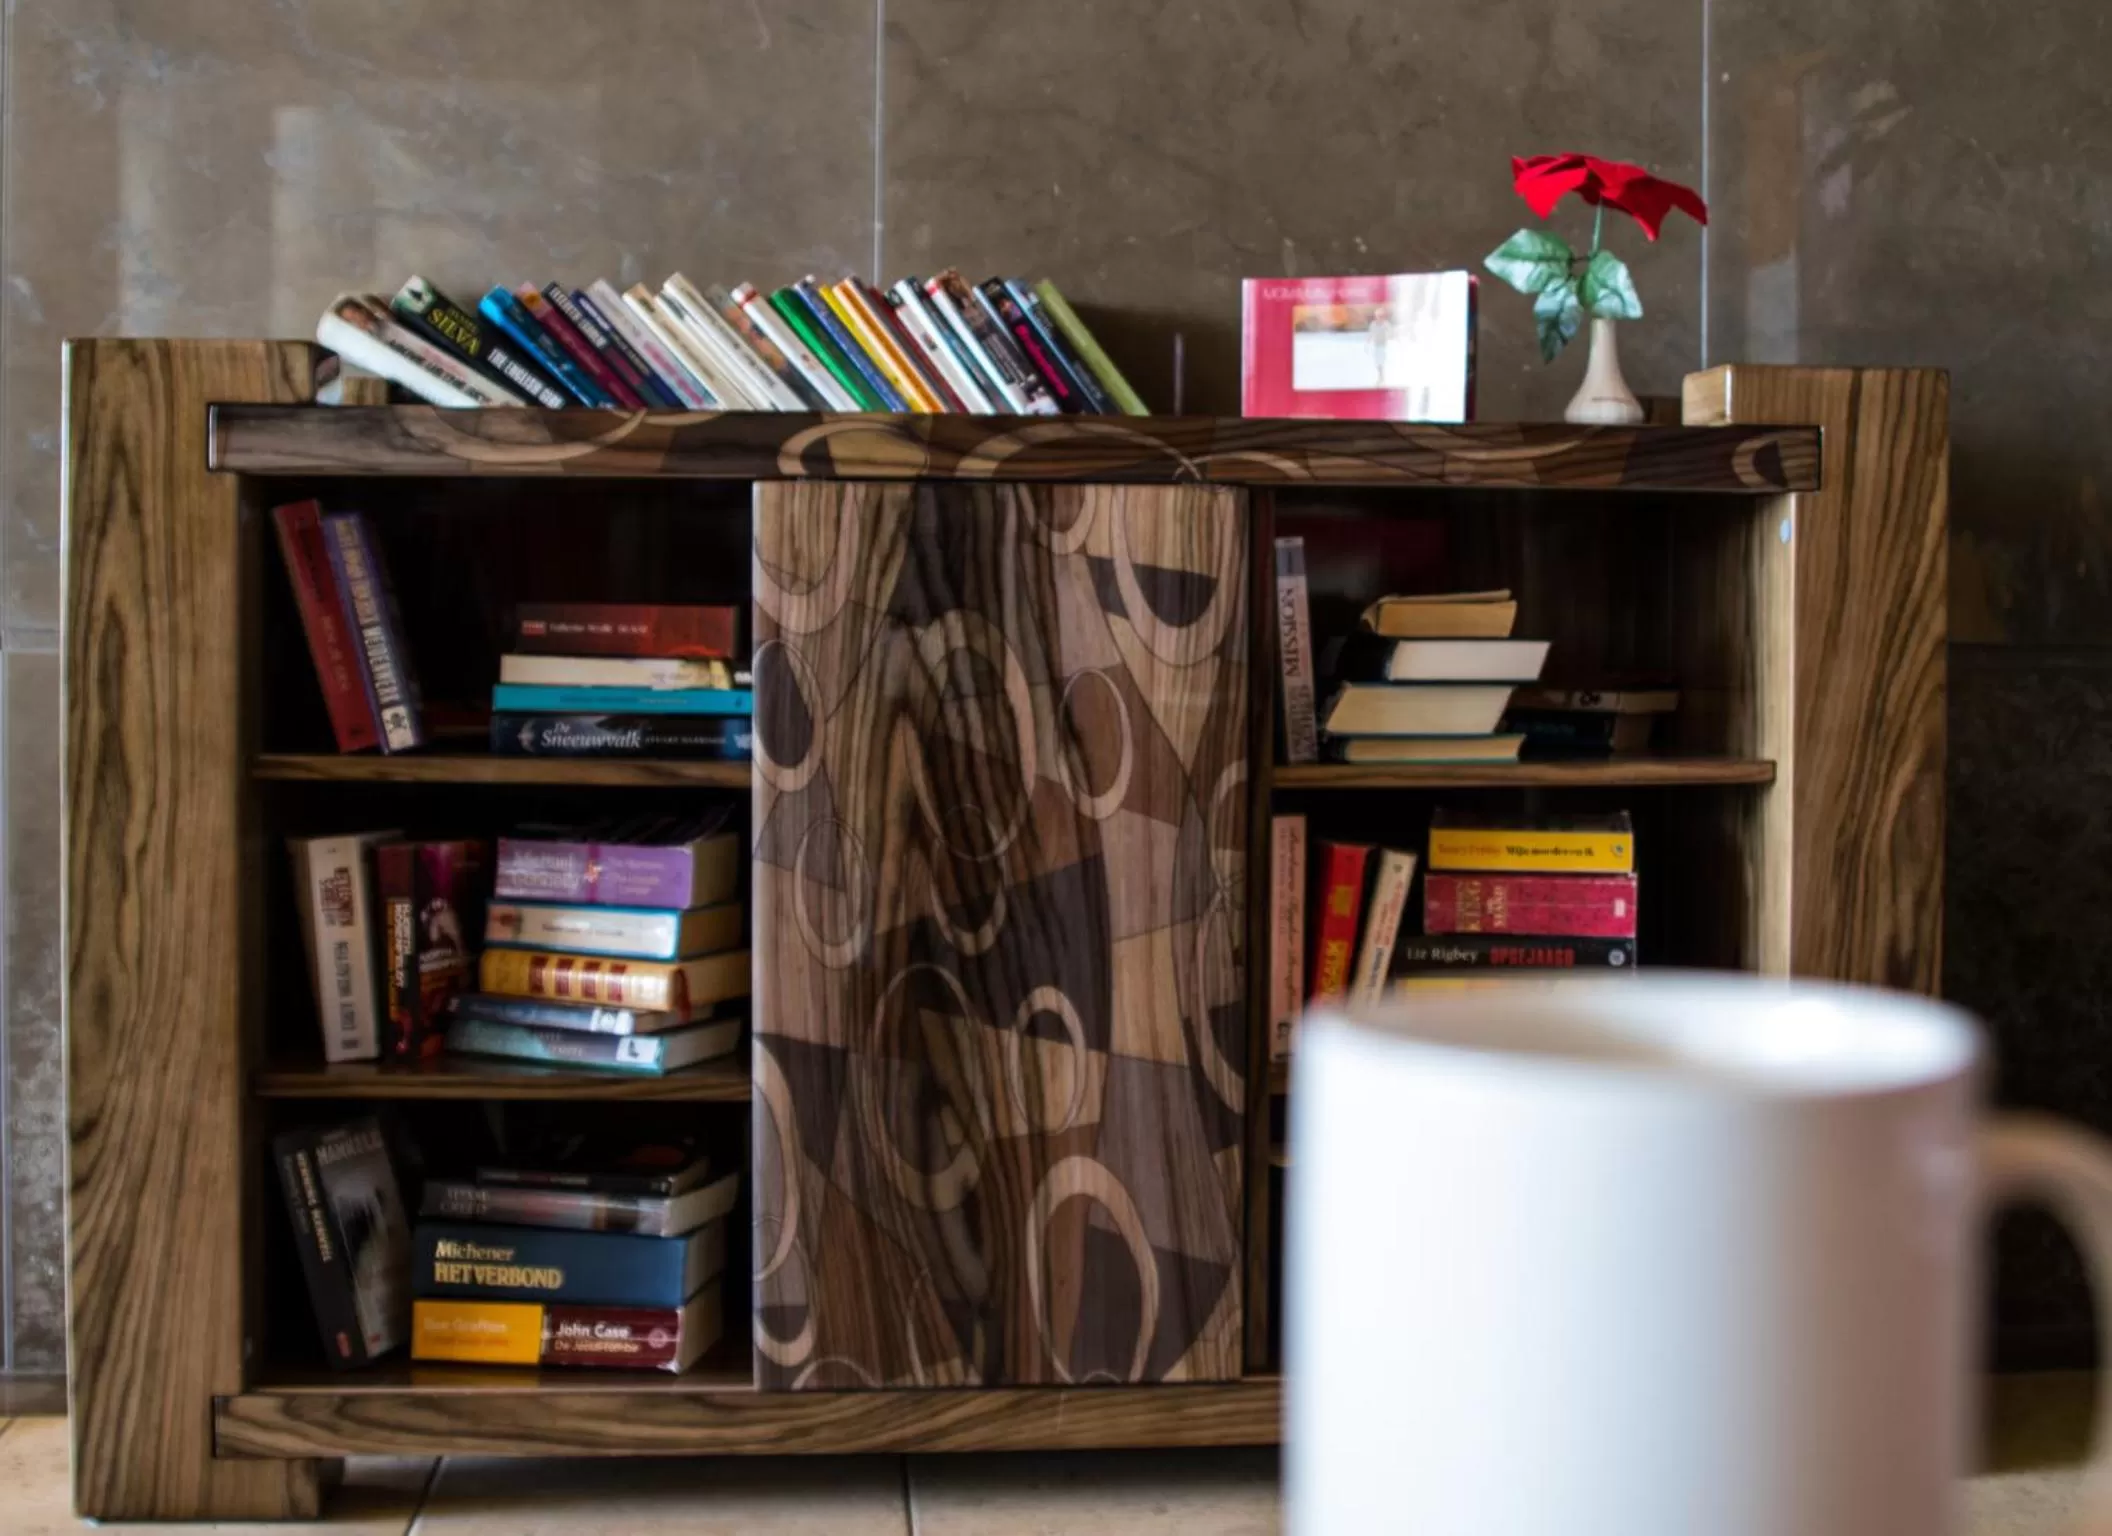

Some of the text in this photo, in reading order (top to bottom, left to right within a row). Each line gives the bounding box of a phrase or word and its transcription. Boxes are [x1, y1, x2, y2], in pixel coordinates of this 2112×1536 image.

[427, 308, 480, 356] SILVA
[503, 359, 543, 397] ENGLISH
[540, 728, 641, 749] Sneeuwvalk
[1407, 947, 1427, 960] Liz
[1431, 947, 1478, 963] Rigbey
[435, 1239, 514, 1261] Michener
[434, 1261, 564, 1289] HET VERBOND
[555, 1320, 631, 1339] John Case
